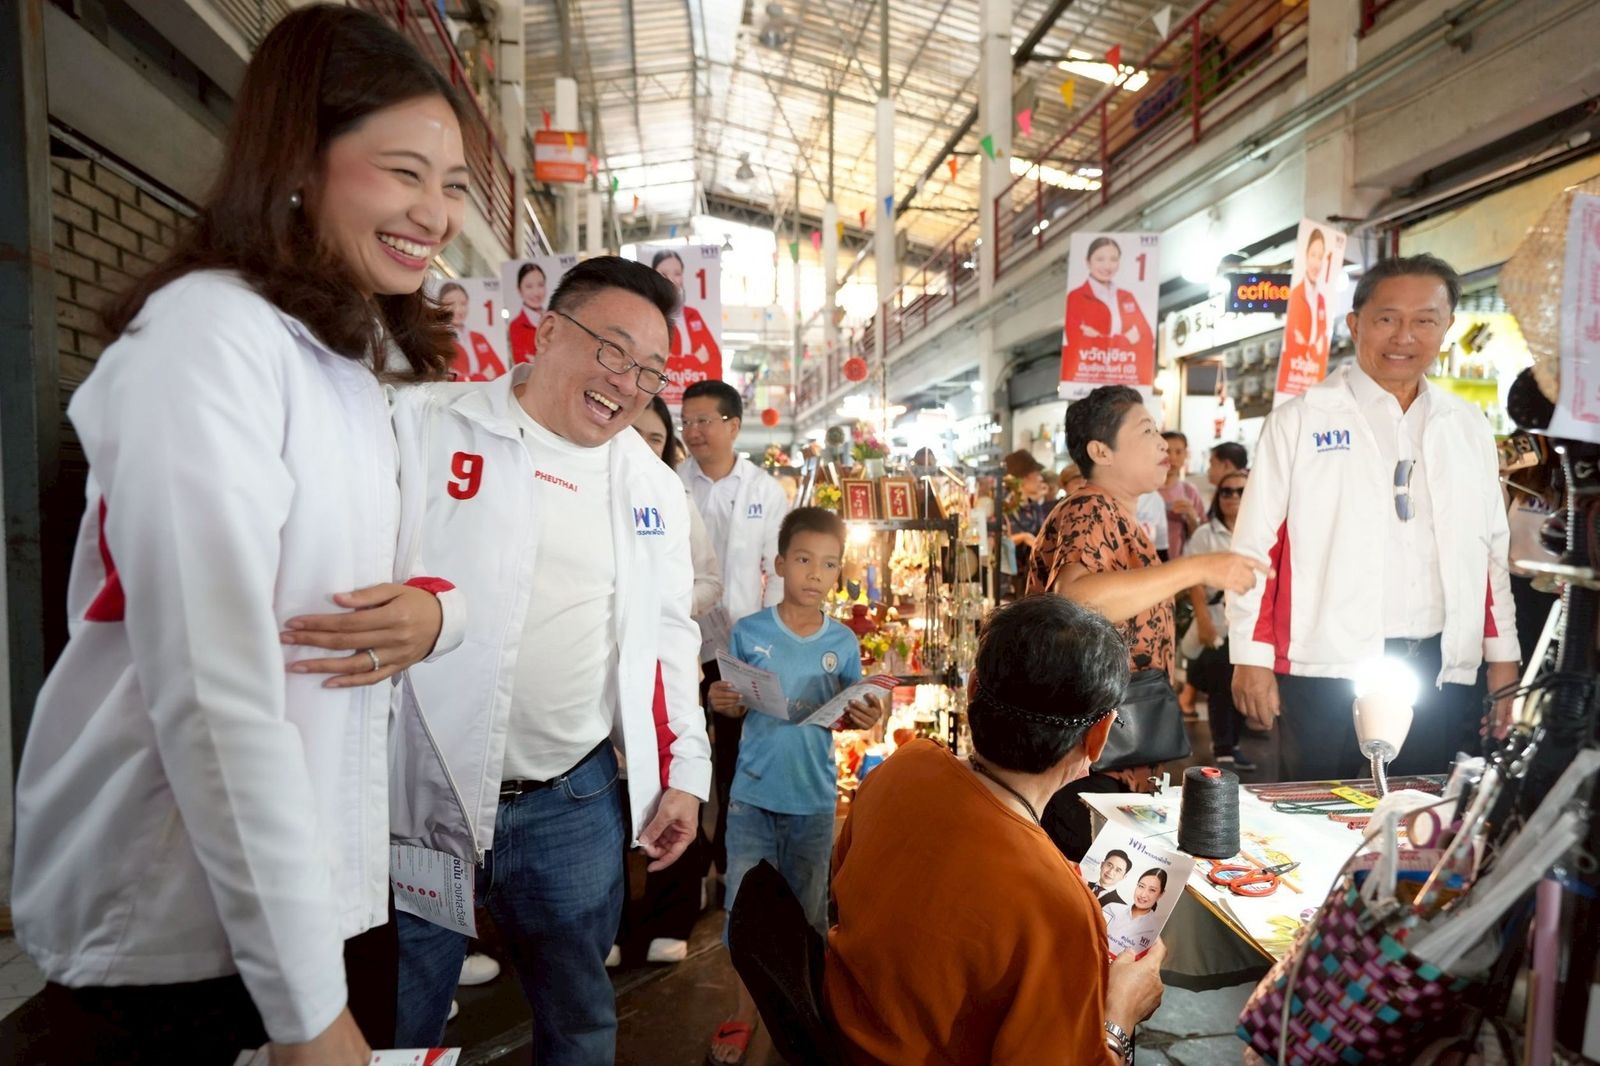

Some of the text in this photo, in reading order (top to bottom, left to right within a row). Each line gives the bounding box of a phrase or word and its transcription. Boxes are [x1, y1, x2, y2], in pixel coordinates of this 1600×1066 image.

[1136, 253, 1146, 282] 1
[695, 269, 706, 300] 1
[1237, 281, 1290, 301] coffee
[484, 300, 493, 326] 1
[1312, 430, 1350, 447] พท
[447, 451, 484, 500] 9
[534, 470, 578, 492] PHEUTHAI
